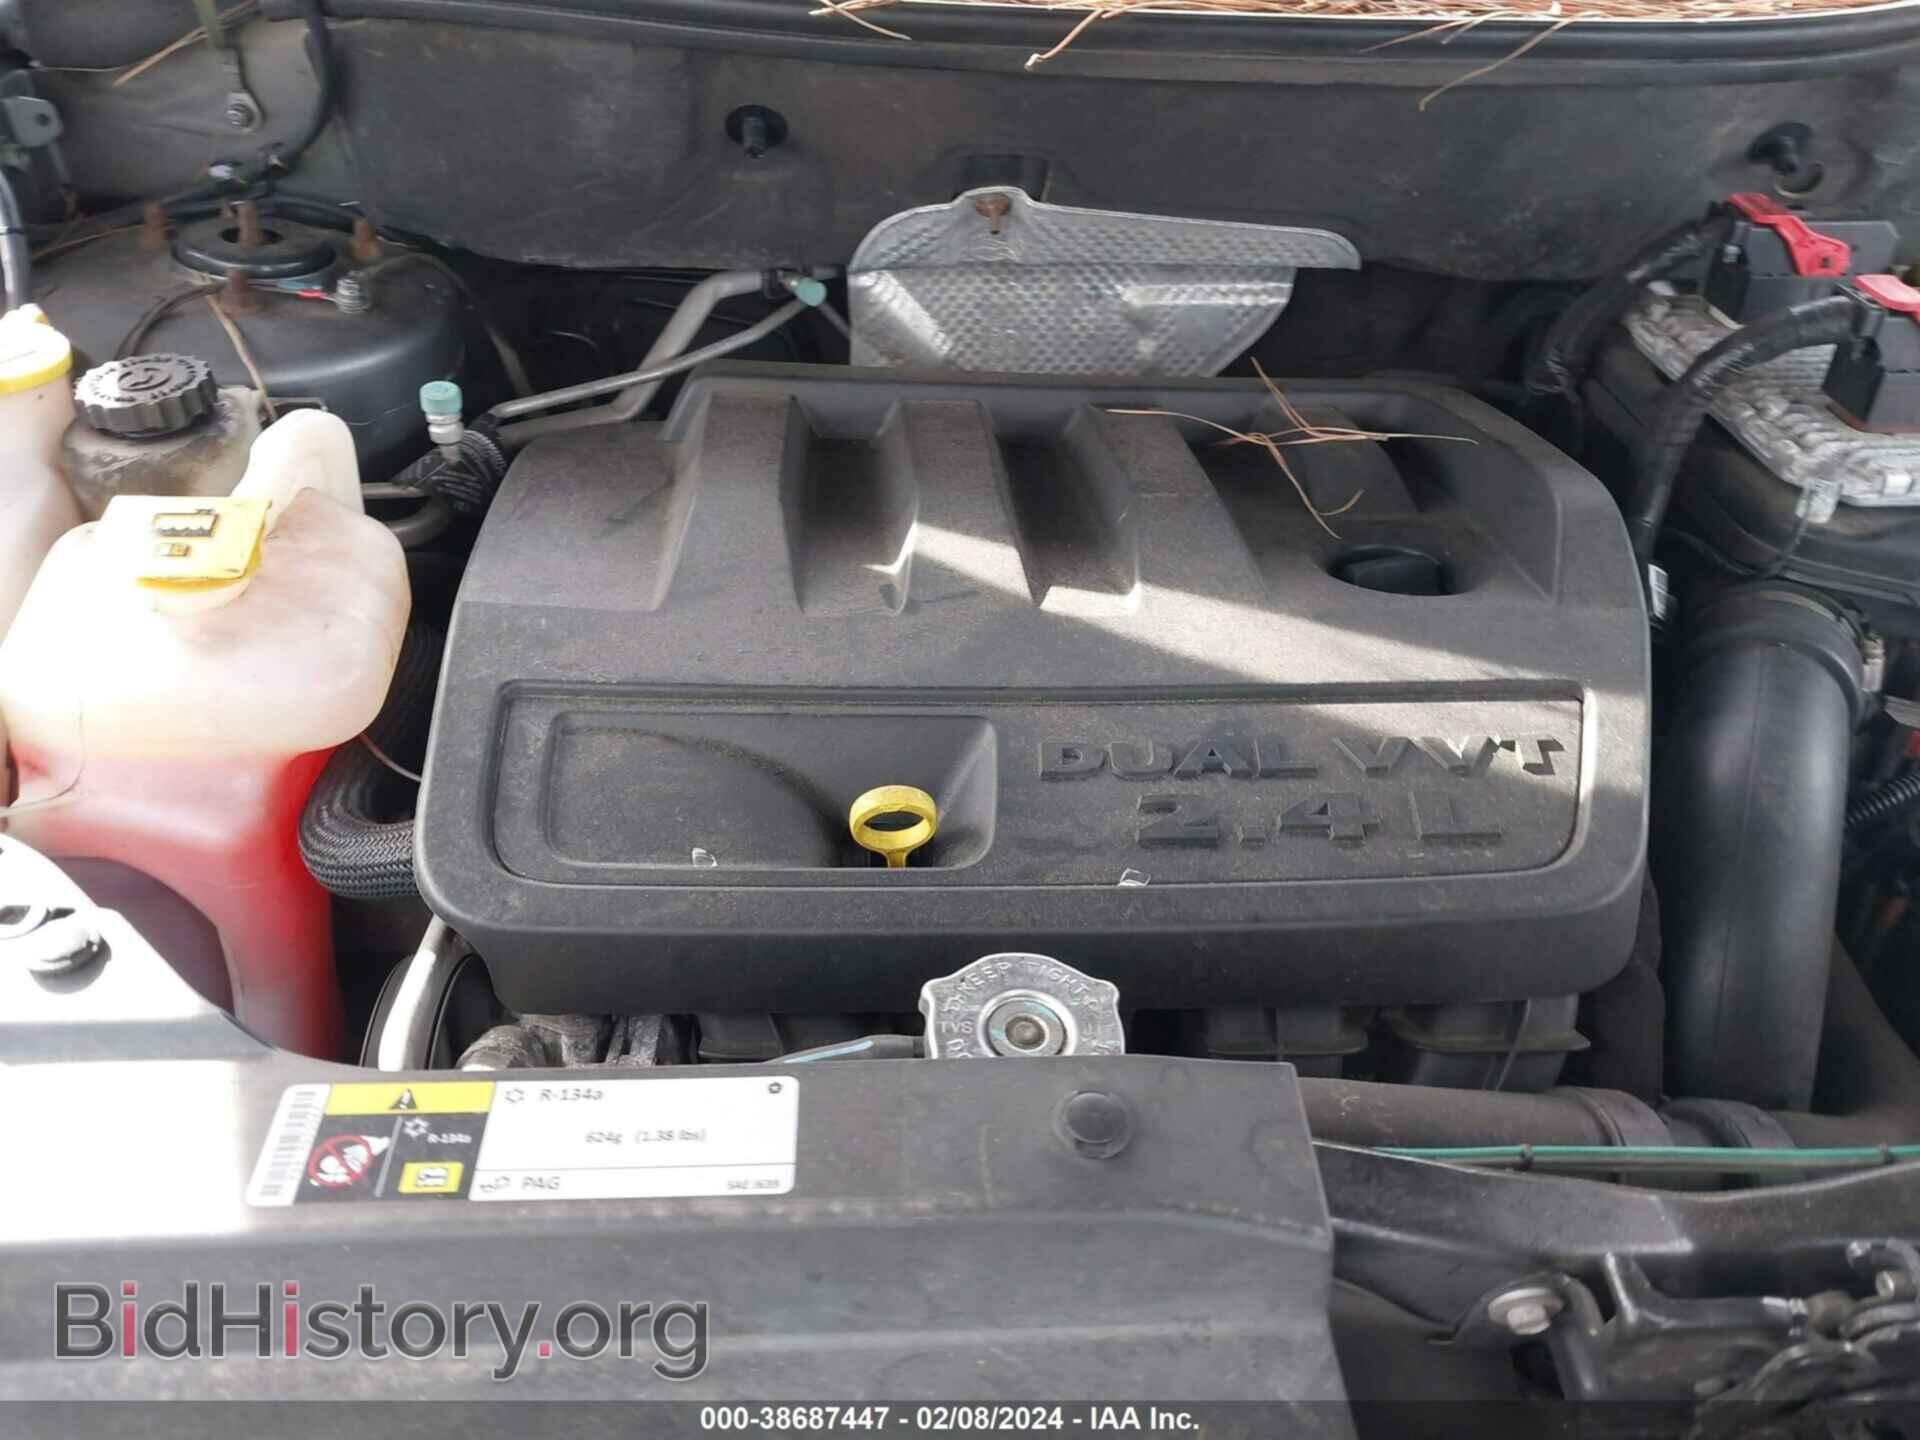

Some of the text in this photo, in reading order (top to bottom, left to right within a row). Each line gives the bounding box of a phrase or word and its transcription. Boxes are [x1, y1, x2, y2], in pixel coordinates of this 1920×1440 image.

[1038, 734, 1565, 780] DUAL VVT
[540, 1087, 605, 1103] R-134a
[521, 1175, 562, 1192] PAG
